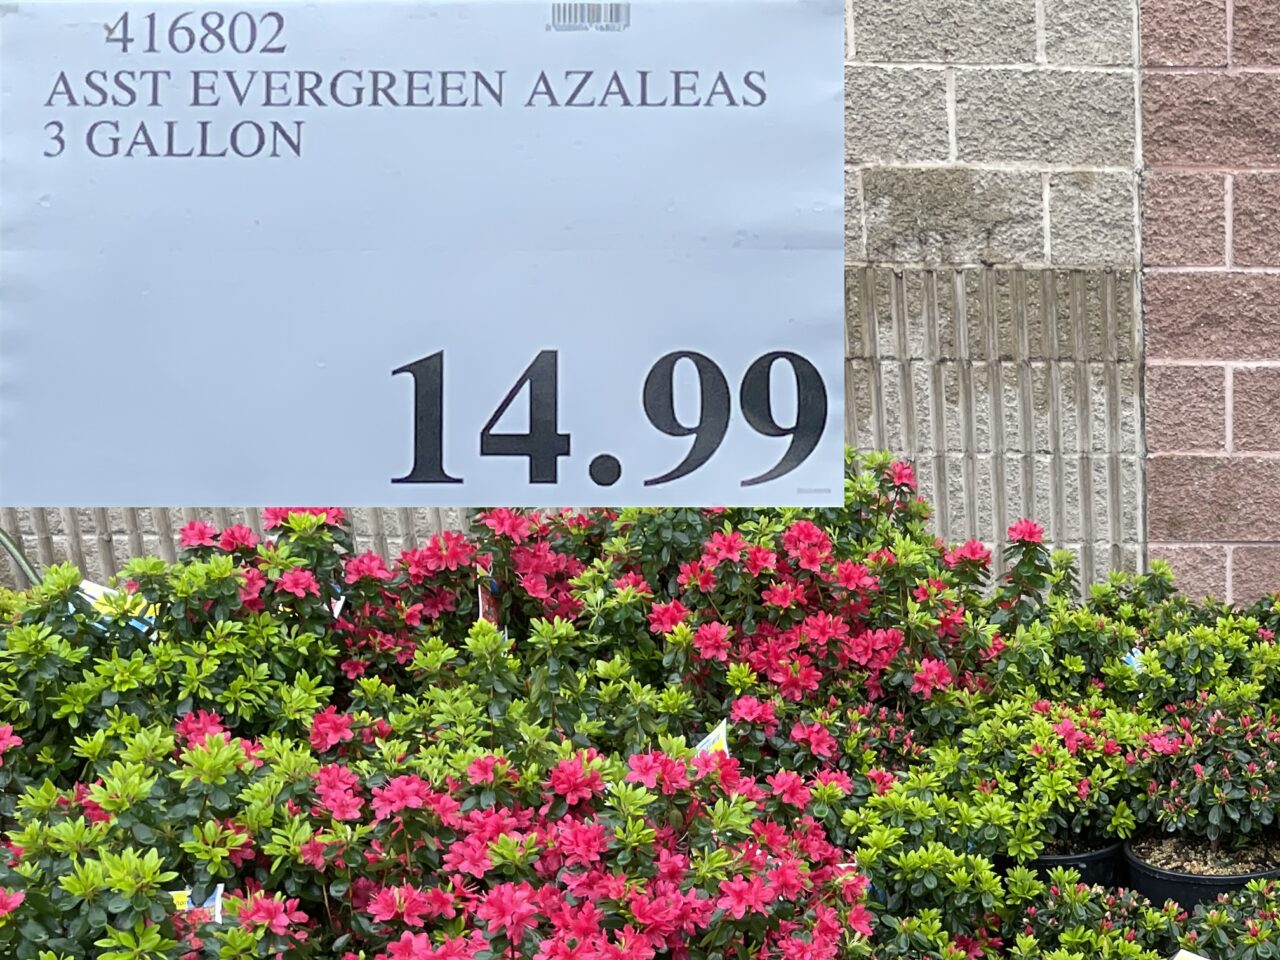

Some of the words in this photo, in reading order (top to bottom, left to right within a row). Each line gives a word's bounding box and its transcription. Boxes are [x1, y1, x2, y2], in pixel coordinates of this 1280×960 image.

[106, 11, 286, 54] 416802
[44, 70, 171, 107] ASST
[190, 70, 506, 108] EVERGREEN
[525, 70, 767, 107] AZALEAS
[43, 120, 66, 158] 3
[86, 120, 304, 158] GALLON
[391, 350, 828, 487] 14.99
